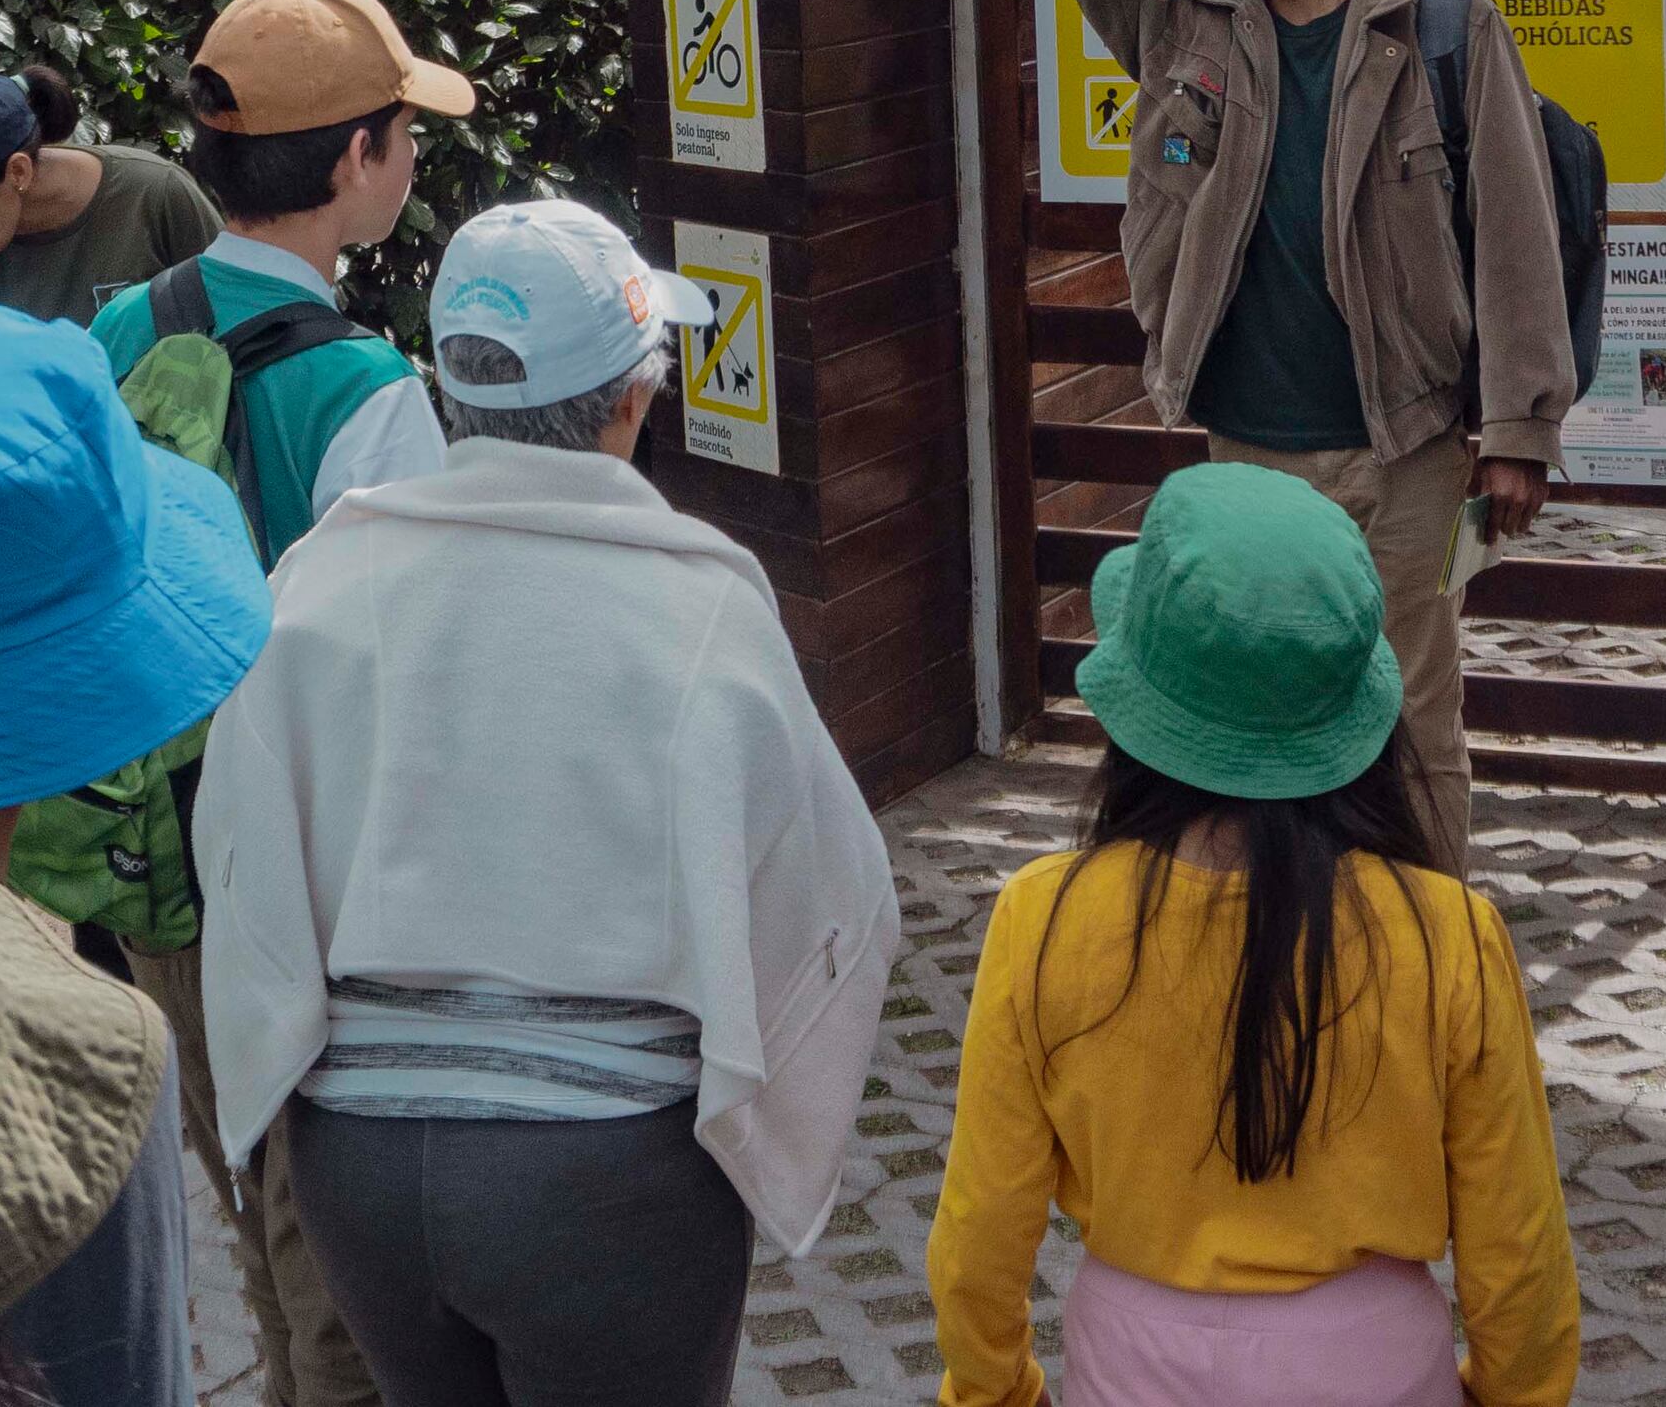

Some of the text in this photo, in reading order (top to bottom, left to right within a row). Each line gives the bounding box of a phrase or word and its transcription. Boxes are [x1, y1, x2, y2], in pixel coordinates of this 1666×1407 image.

[1512, 21, 1633, 46] OHÓLICAS
[675, 122, 731, 143] Solo ingreso
[677, 142, 716, 157] peatonal
[1610, 306, 1623, 314] DEL
[1625, 304, 1638, 314] RÍO
[1639, 306, 1655, 314] SAN
[1601, 332, 1634, 340] ONTONES
[1635, 332, 1645, 340] DE
[688, 417, 732, 440] Prohibido
